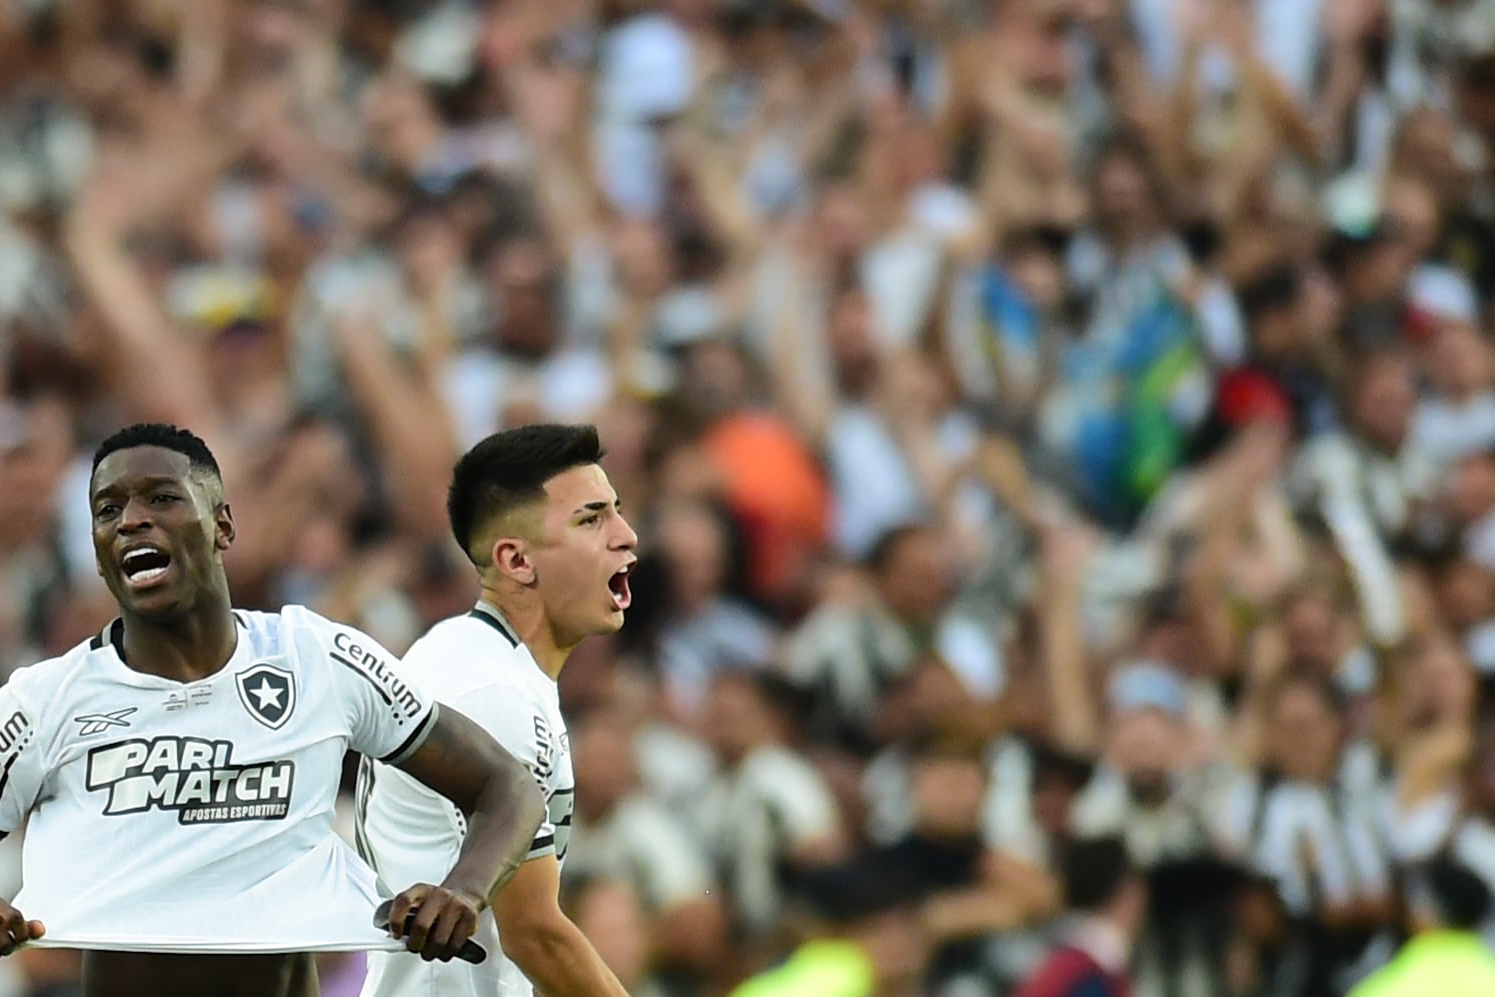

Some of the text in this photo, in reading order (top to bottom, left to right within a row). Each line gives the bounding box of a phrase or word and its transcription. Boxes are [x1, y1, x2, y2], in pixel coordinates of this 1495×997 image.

[333, 632, 422, 719] Centrum
[89, 740, 229, 787] PARI
[107, 764, 292, 814] MATCH
[182, 803, 286, 822] APOSTAS ESPORTIVAS
